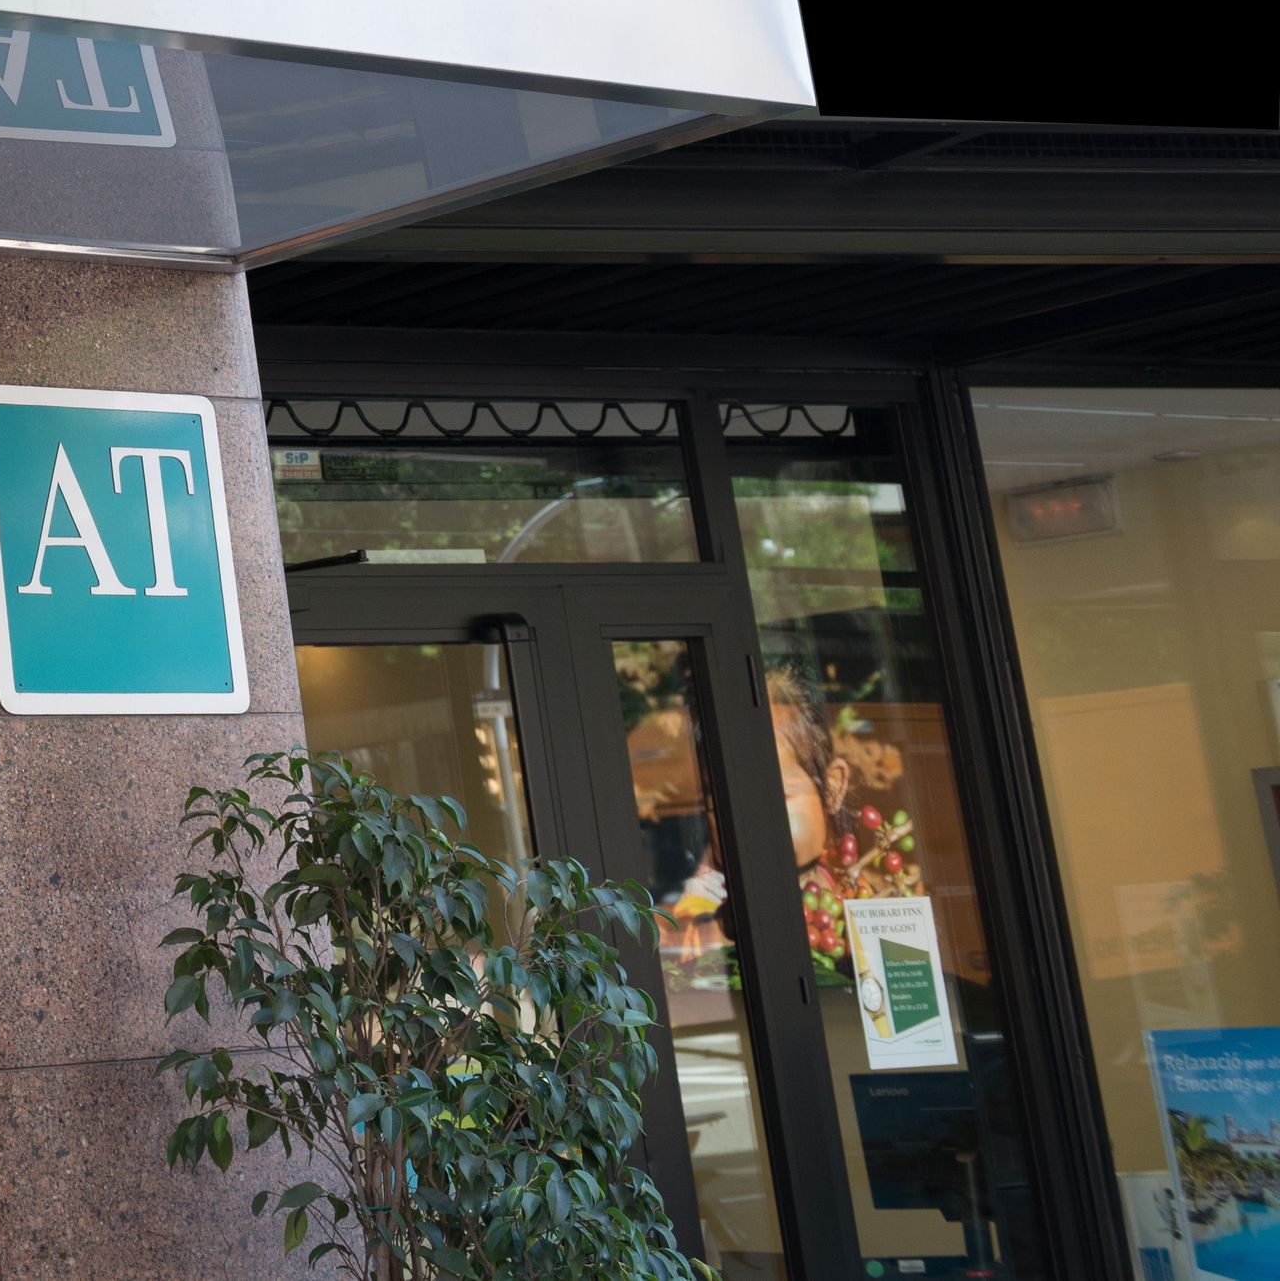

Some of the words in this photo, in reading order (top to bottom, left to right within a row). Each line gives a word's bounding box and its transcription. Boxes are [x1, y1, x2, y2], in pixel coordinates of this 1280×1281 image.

[17, 441, 195, 598] AT
[868, 908, 902, 918] HORARI
[903, 907, 922, 917] FINS
